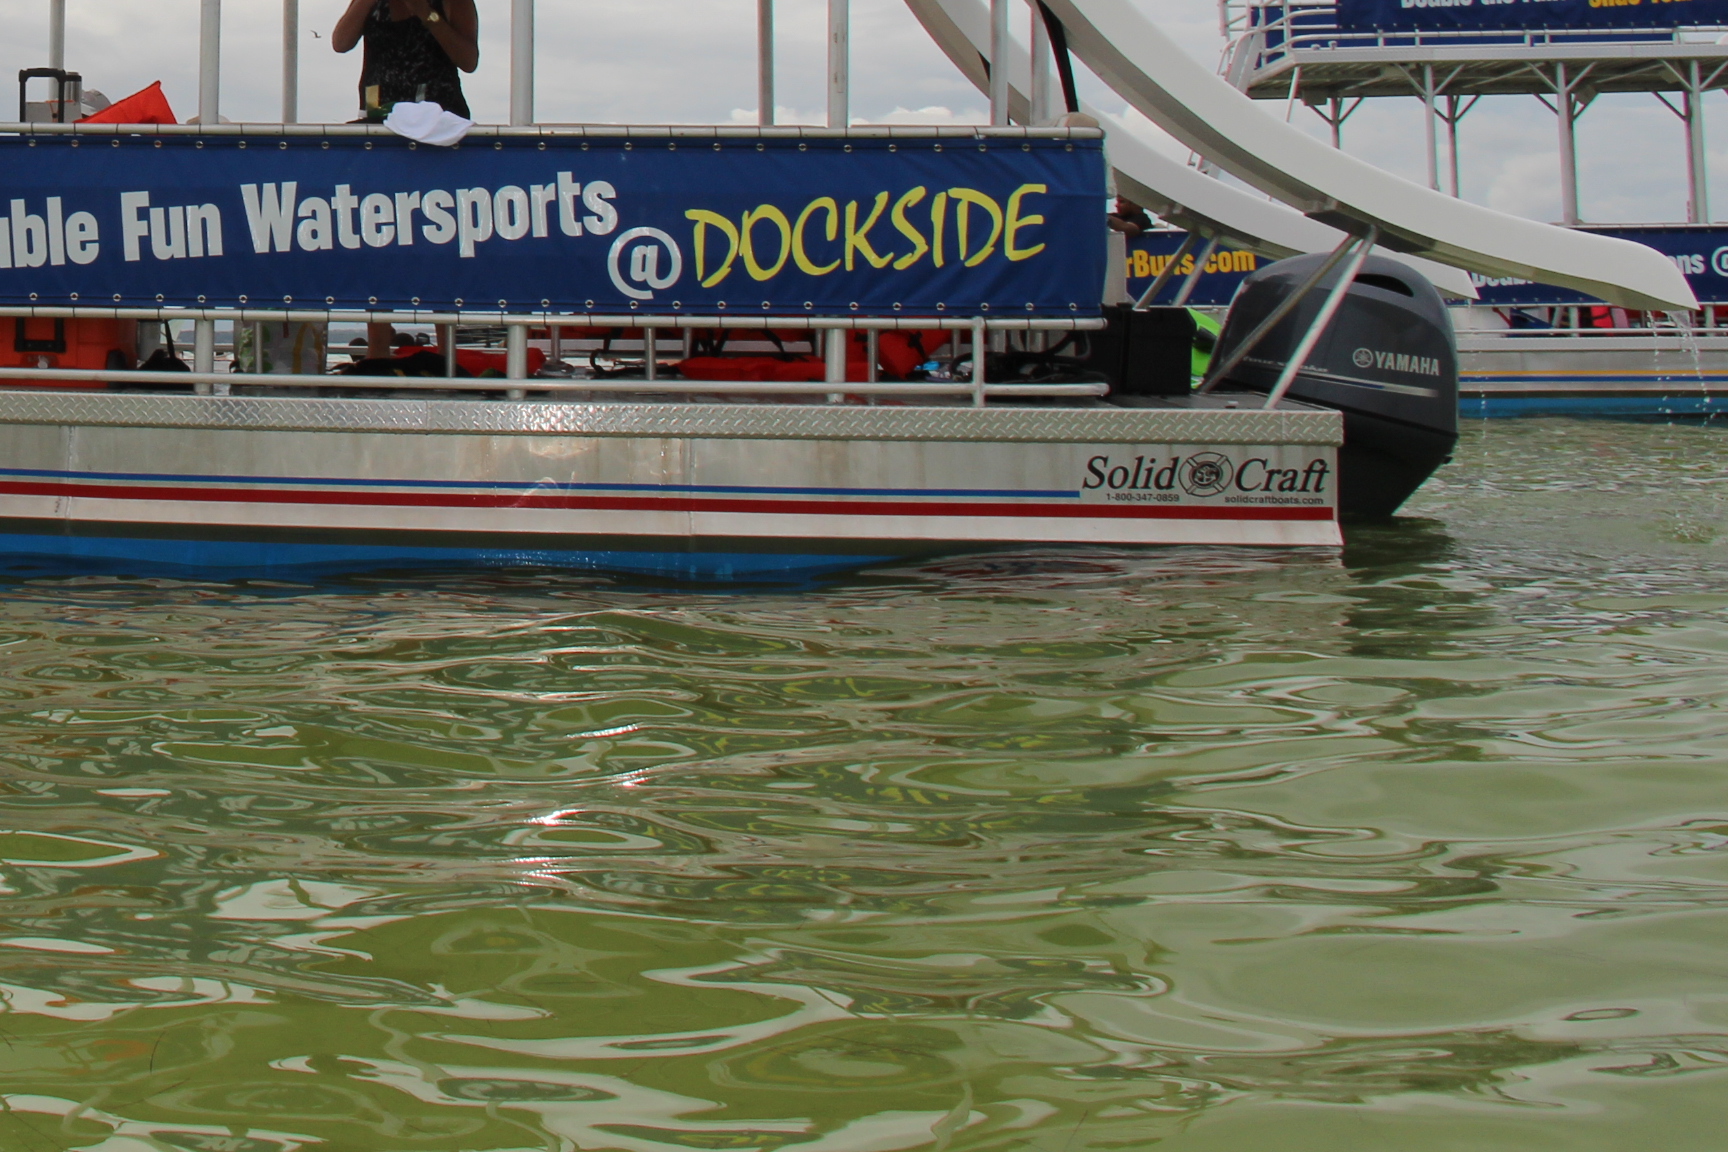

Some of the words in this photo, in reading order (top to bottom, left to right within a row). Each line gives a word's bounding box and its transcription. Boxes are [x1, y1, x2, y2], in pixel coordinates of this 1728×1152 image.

[121, 192, 223, 261] Fun
[241, 172, 618, 258] Watersports
[1374, 350, 1441, 376] YAMAHA
[1082, 456, 1180, 491] Solid
[1235, 458, 1330, 493] Craft
[1105, 492, 1180, 503] 1-800-347-0859
[1224, 495, 1324, 505] solidcraftboats.com
